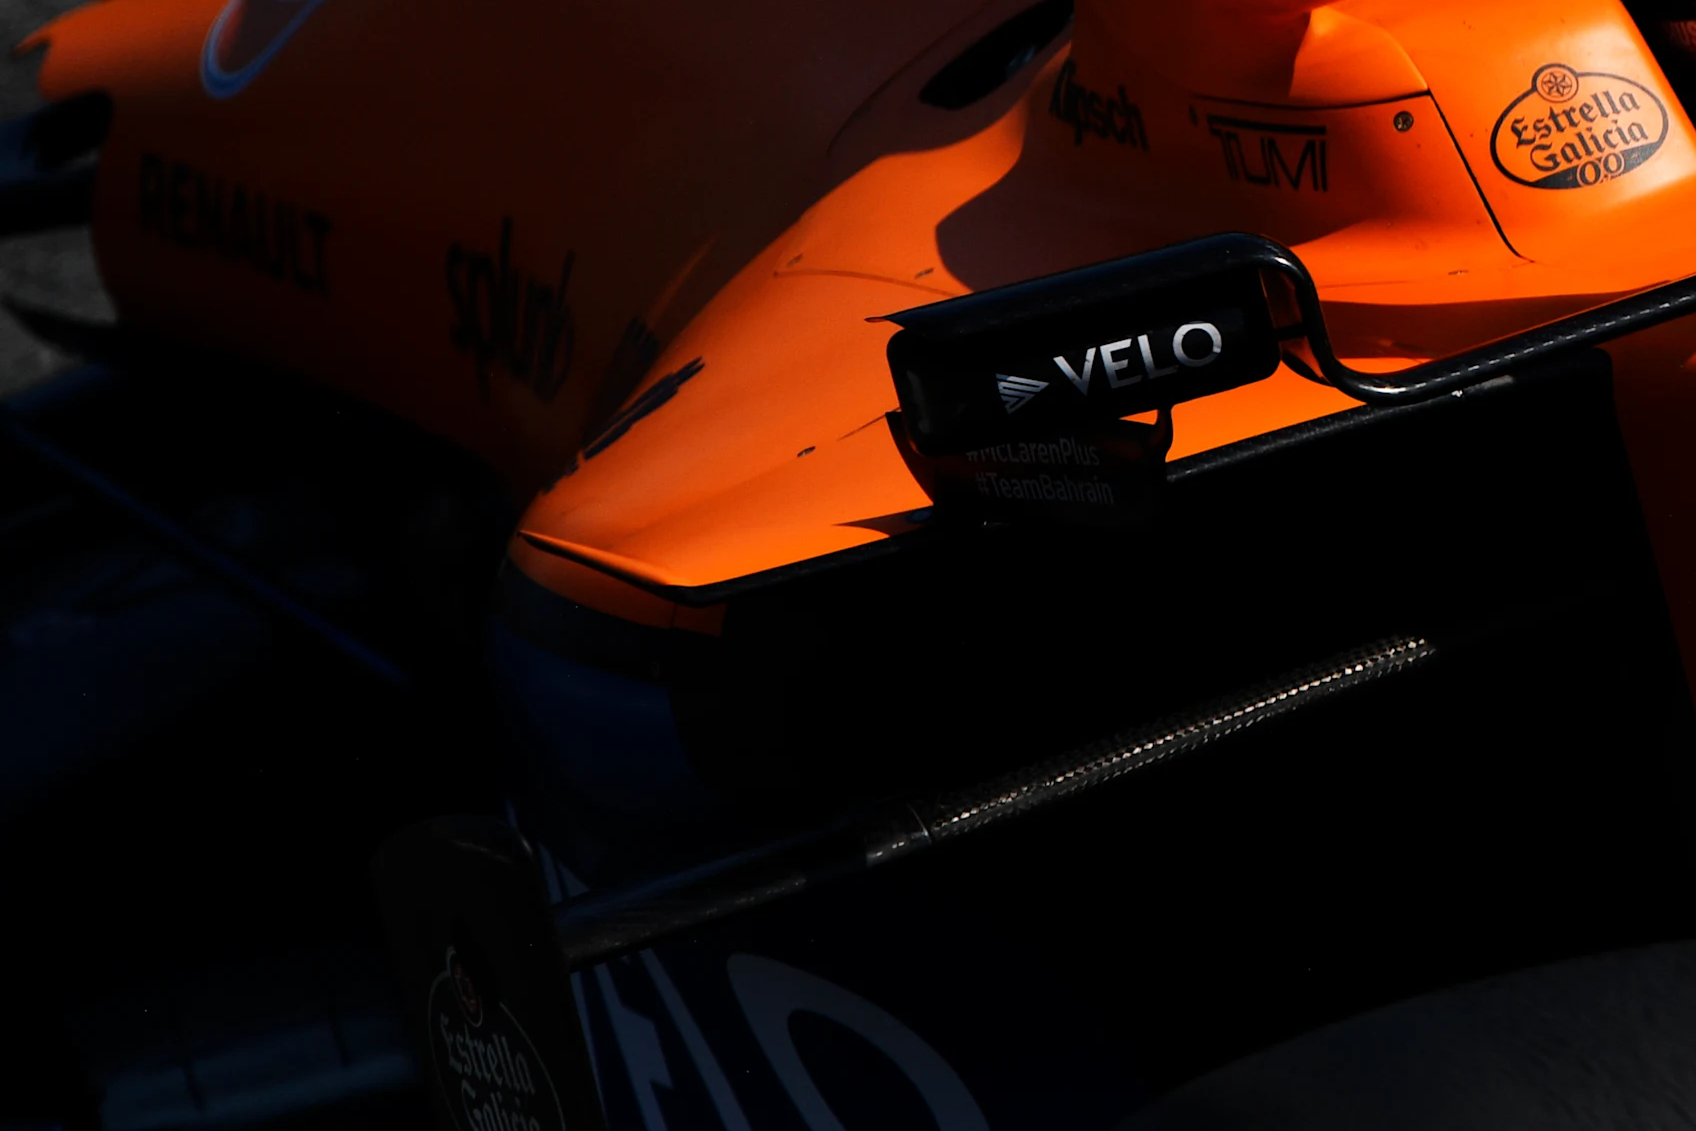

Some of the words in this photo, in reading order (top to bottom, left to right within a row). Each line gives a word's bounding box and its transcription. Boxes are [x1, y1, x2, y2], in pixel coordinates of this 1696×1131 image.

[1510, 89, 1641, 149] Estrella
[1529, 119, 1649, 172] Galicia
[1208, 127, 1328, 193] TUMI
[140, 153, 332, 298] RENAULT
[1053, 320, 1224, 397] VELO
[975, 472, 1117, 506] #TeamBahrain
[440, 1013, 537, 1096] Estrella
